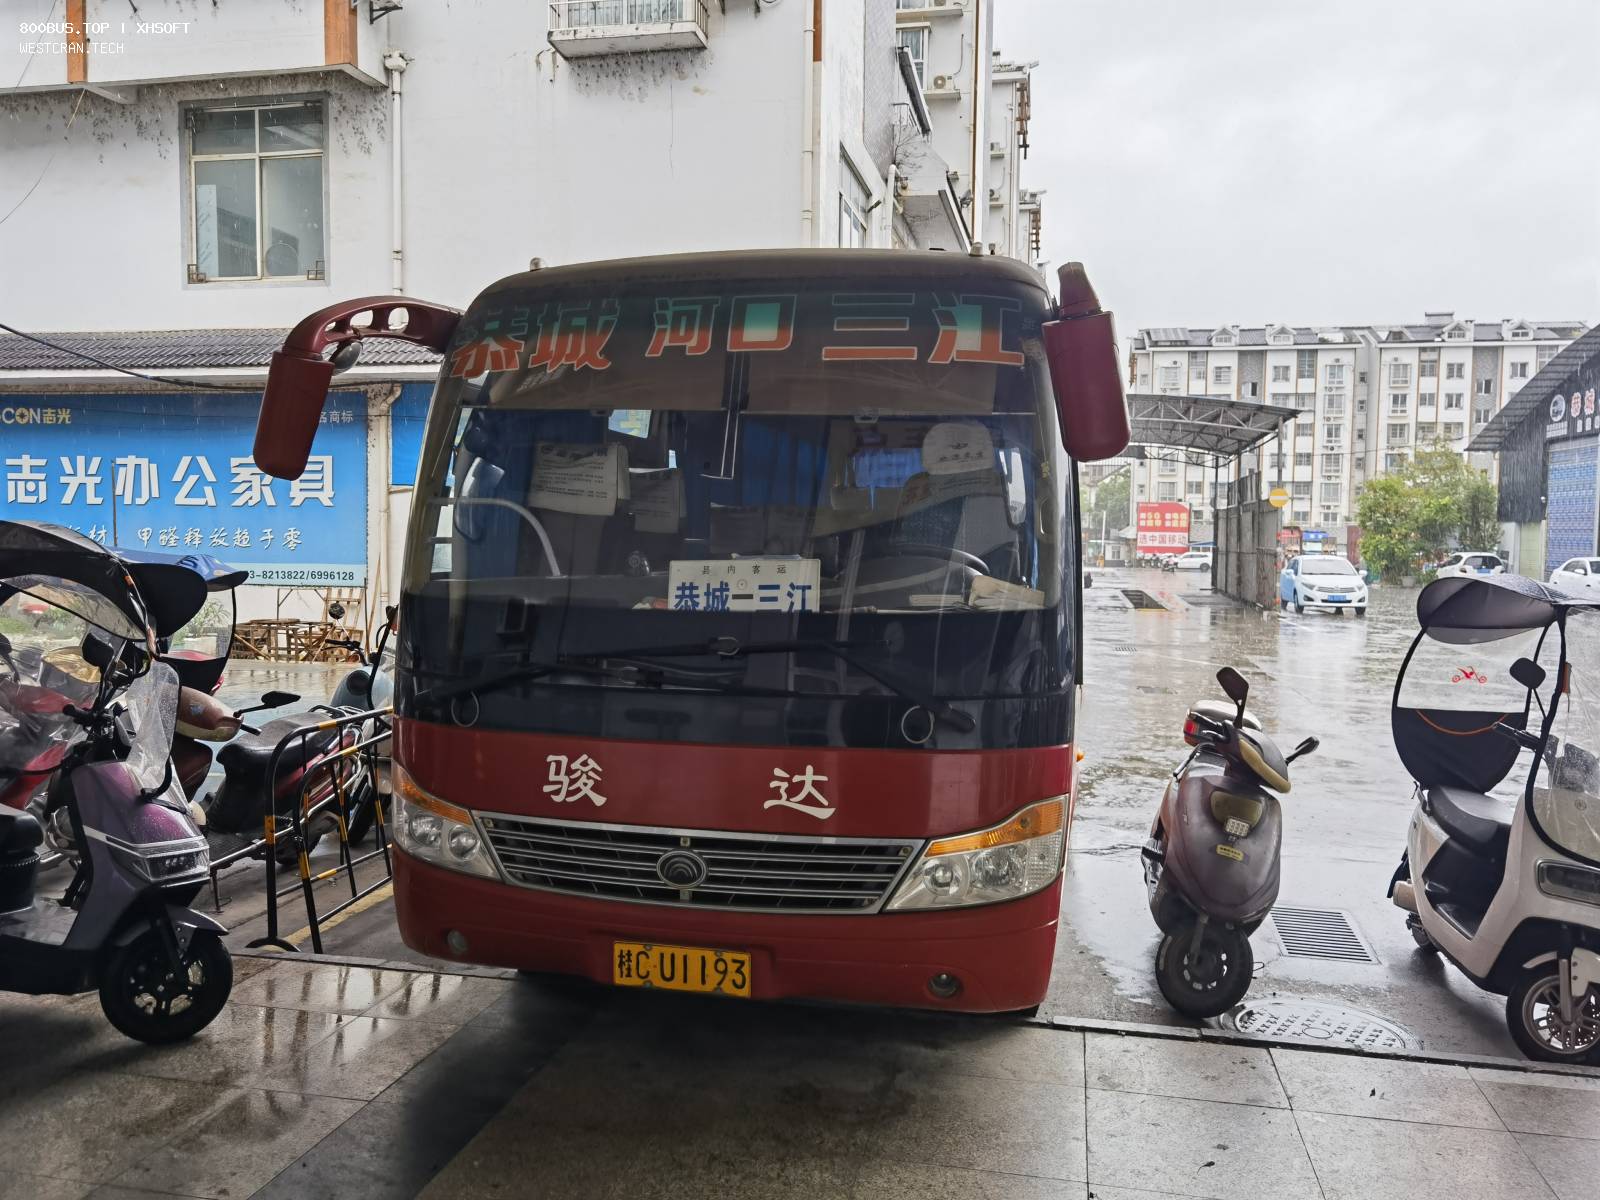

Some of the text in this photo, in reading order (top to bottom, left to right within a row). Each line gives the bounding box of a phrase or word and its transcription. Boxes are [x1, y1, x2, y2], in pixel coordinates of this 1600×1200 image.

[450, 299, 620, 379] 恭城
[645, 295, 798, 358] 河口
[822, 292, 1025, 366] 三江
[5, 454, 335, 508] 志光办公家具
[249, 570, 355, 581] 3-8213822/6996128
